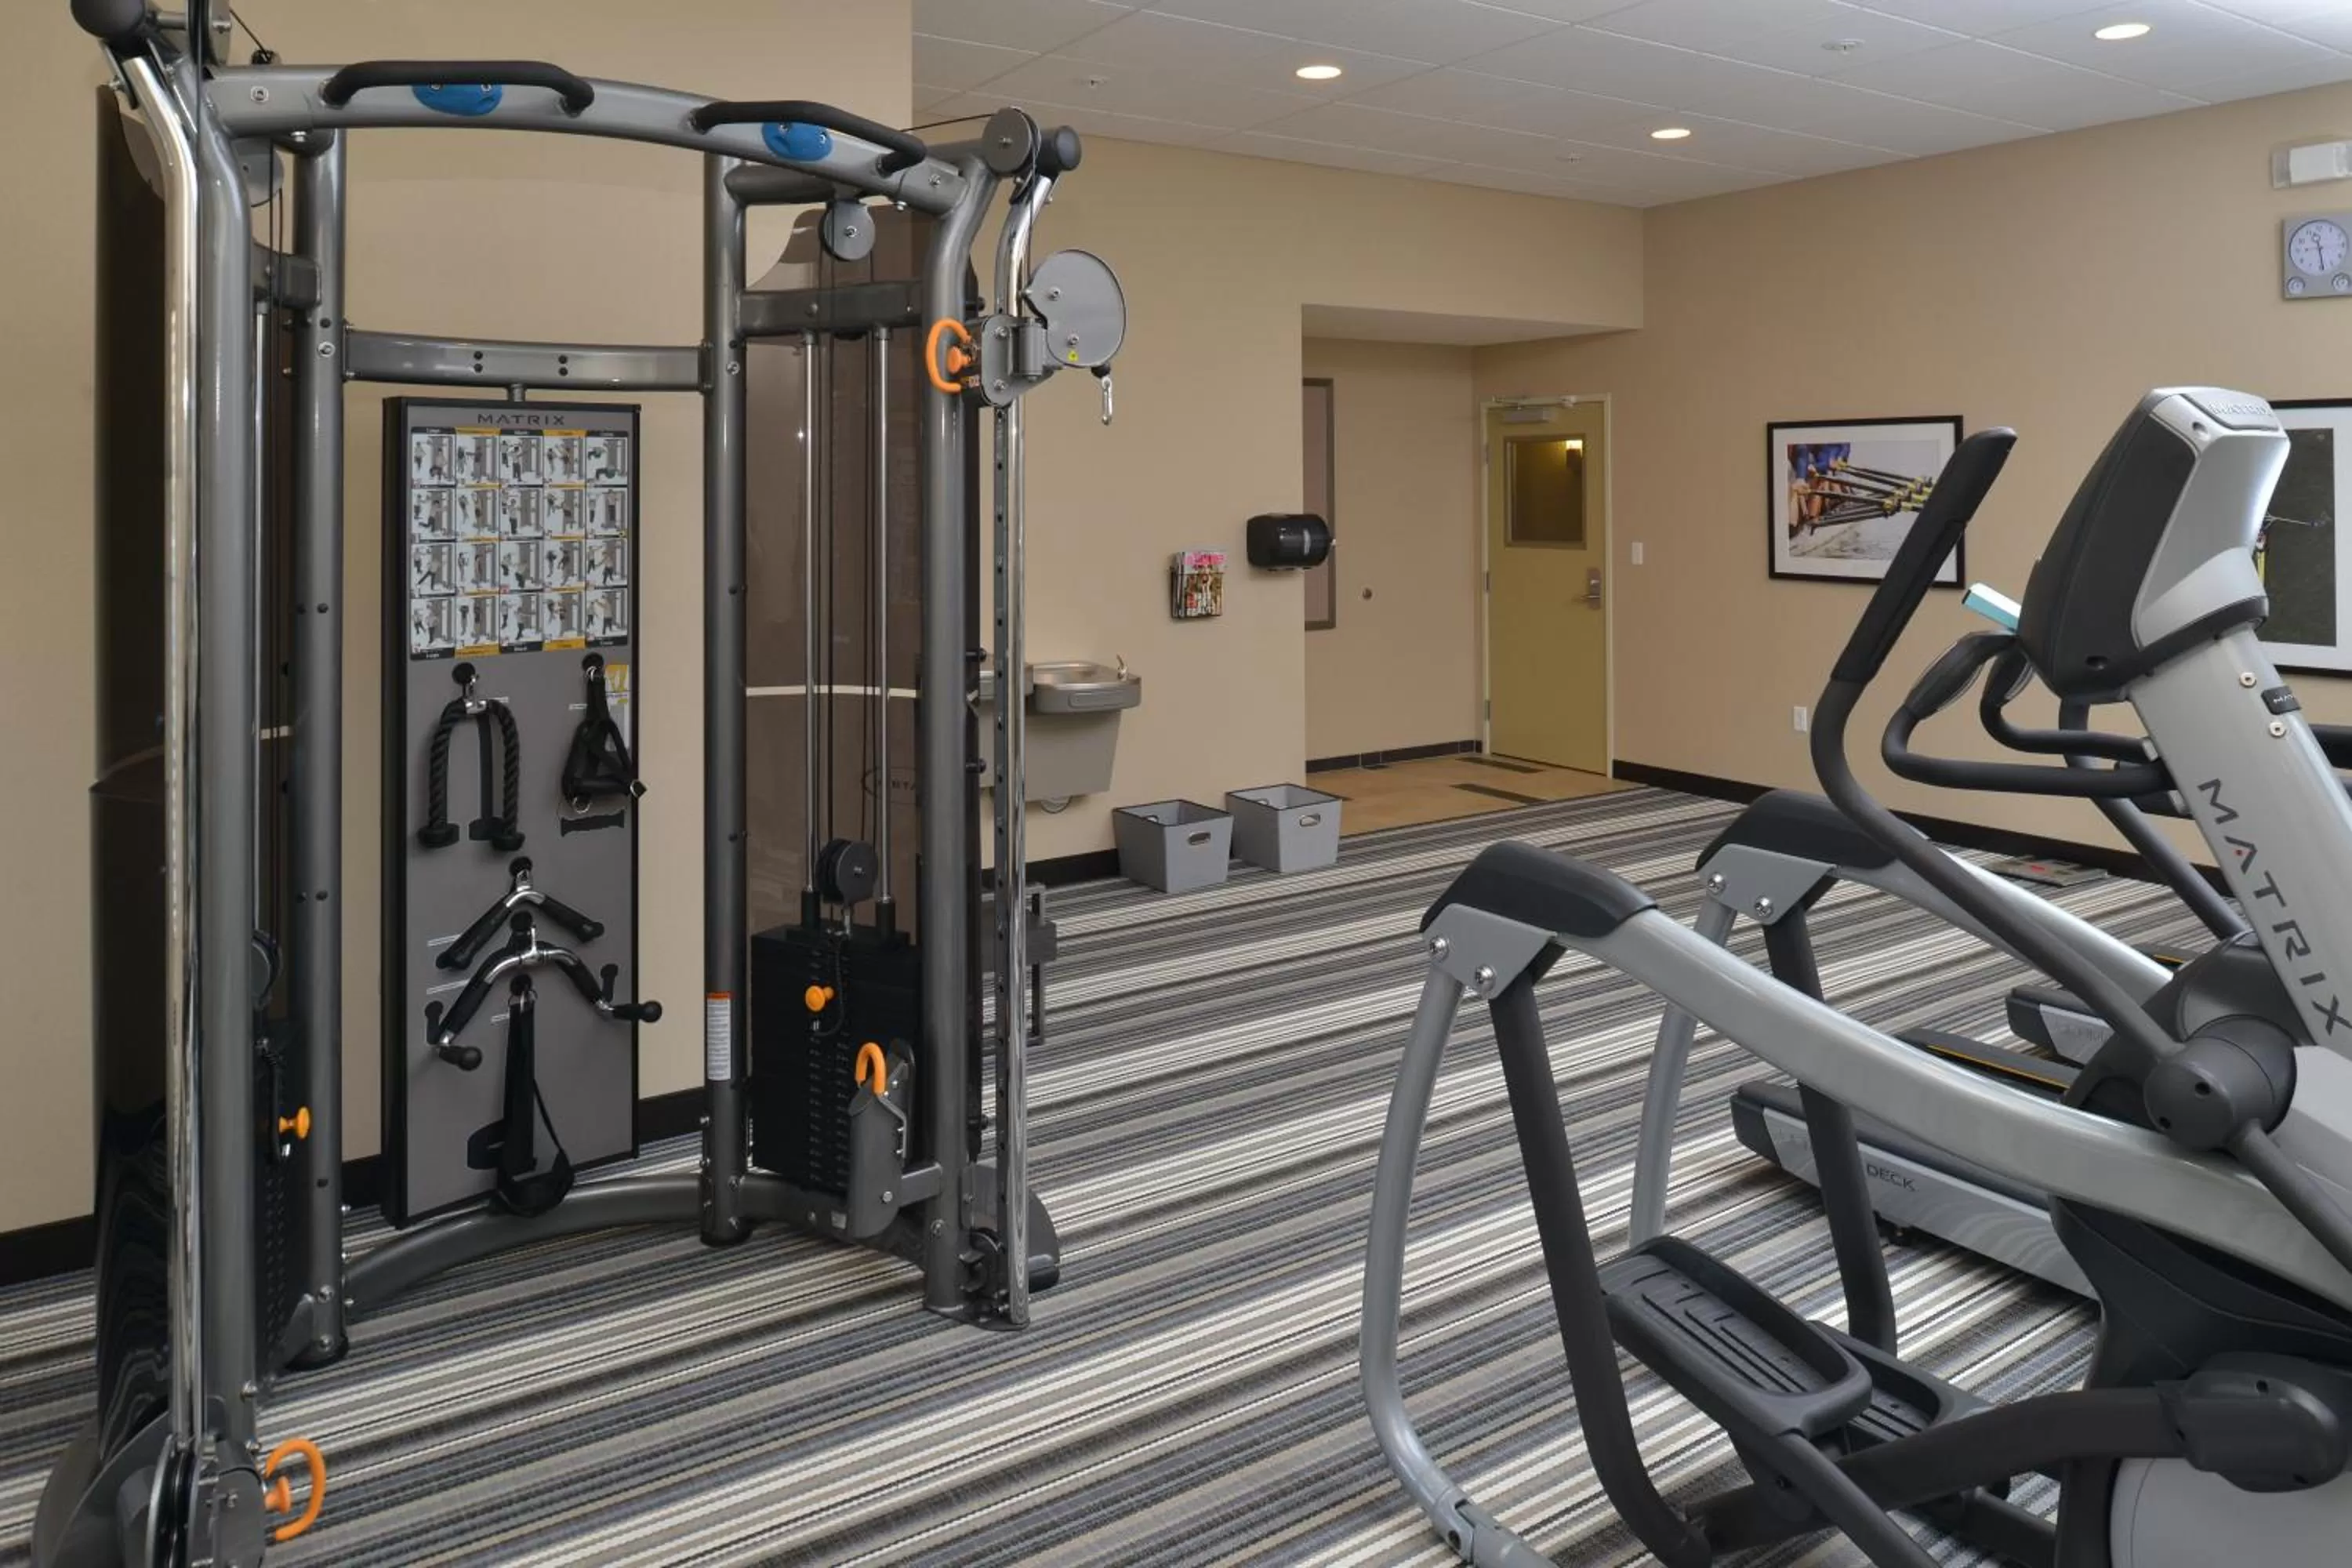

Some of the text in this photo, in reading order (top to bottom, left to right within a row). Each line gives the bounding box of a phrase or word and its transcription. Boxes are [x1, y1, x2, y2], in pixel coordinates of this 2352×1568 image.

[477, 413, 565, 426] MATRIX
[2198, 778, 2352, 1036] MATRIX
[1867, 1163, 1917, 1192] DECK
